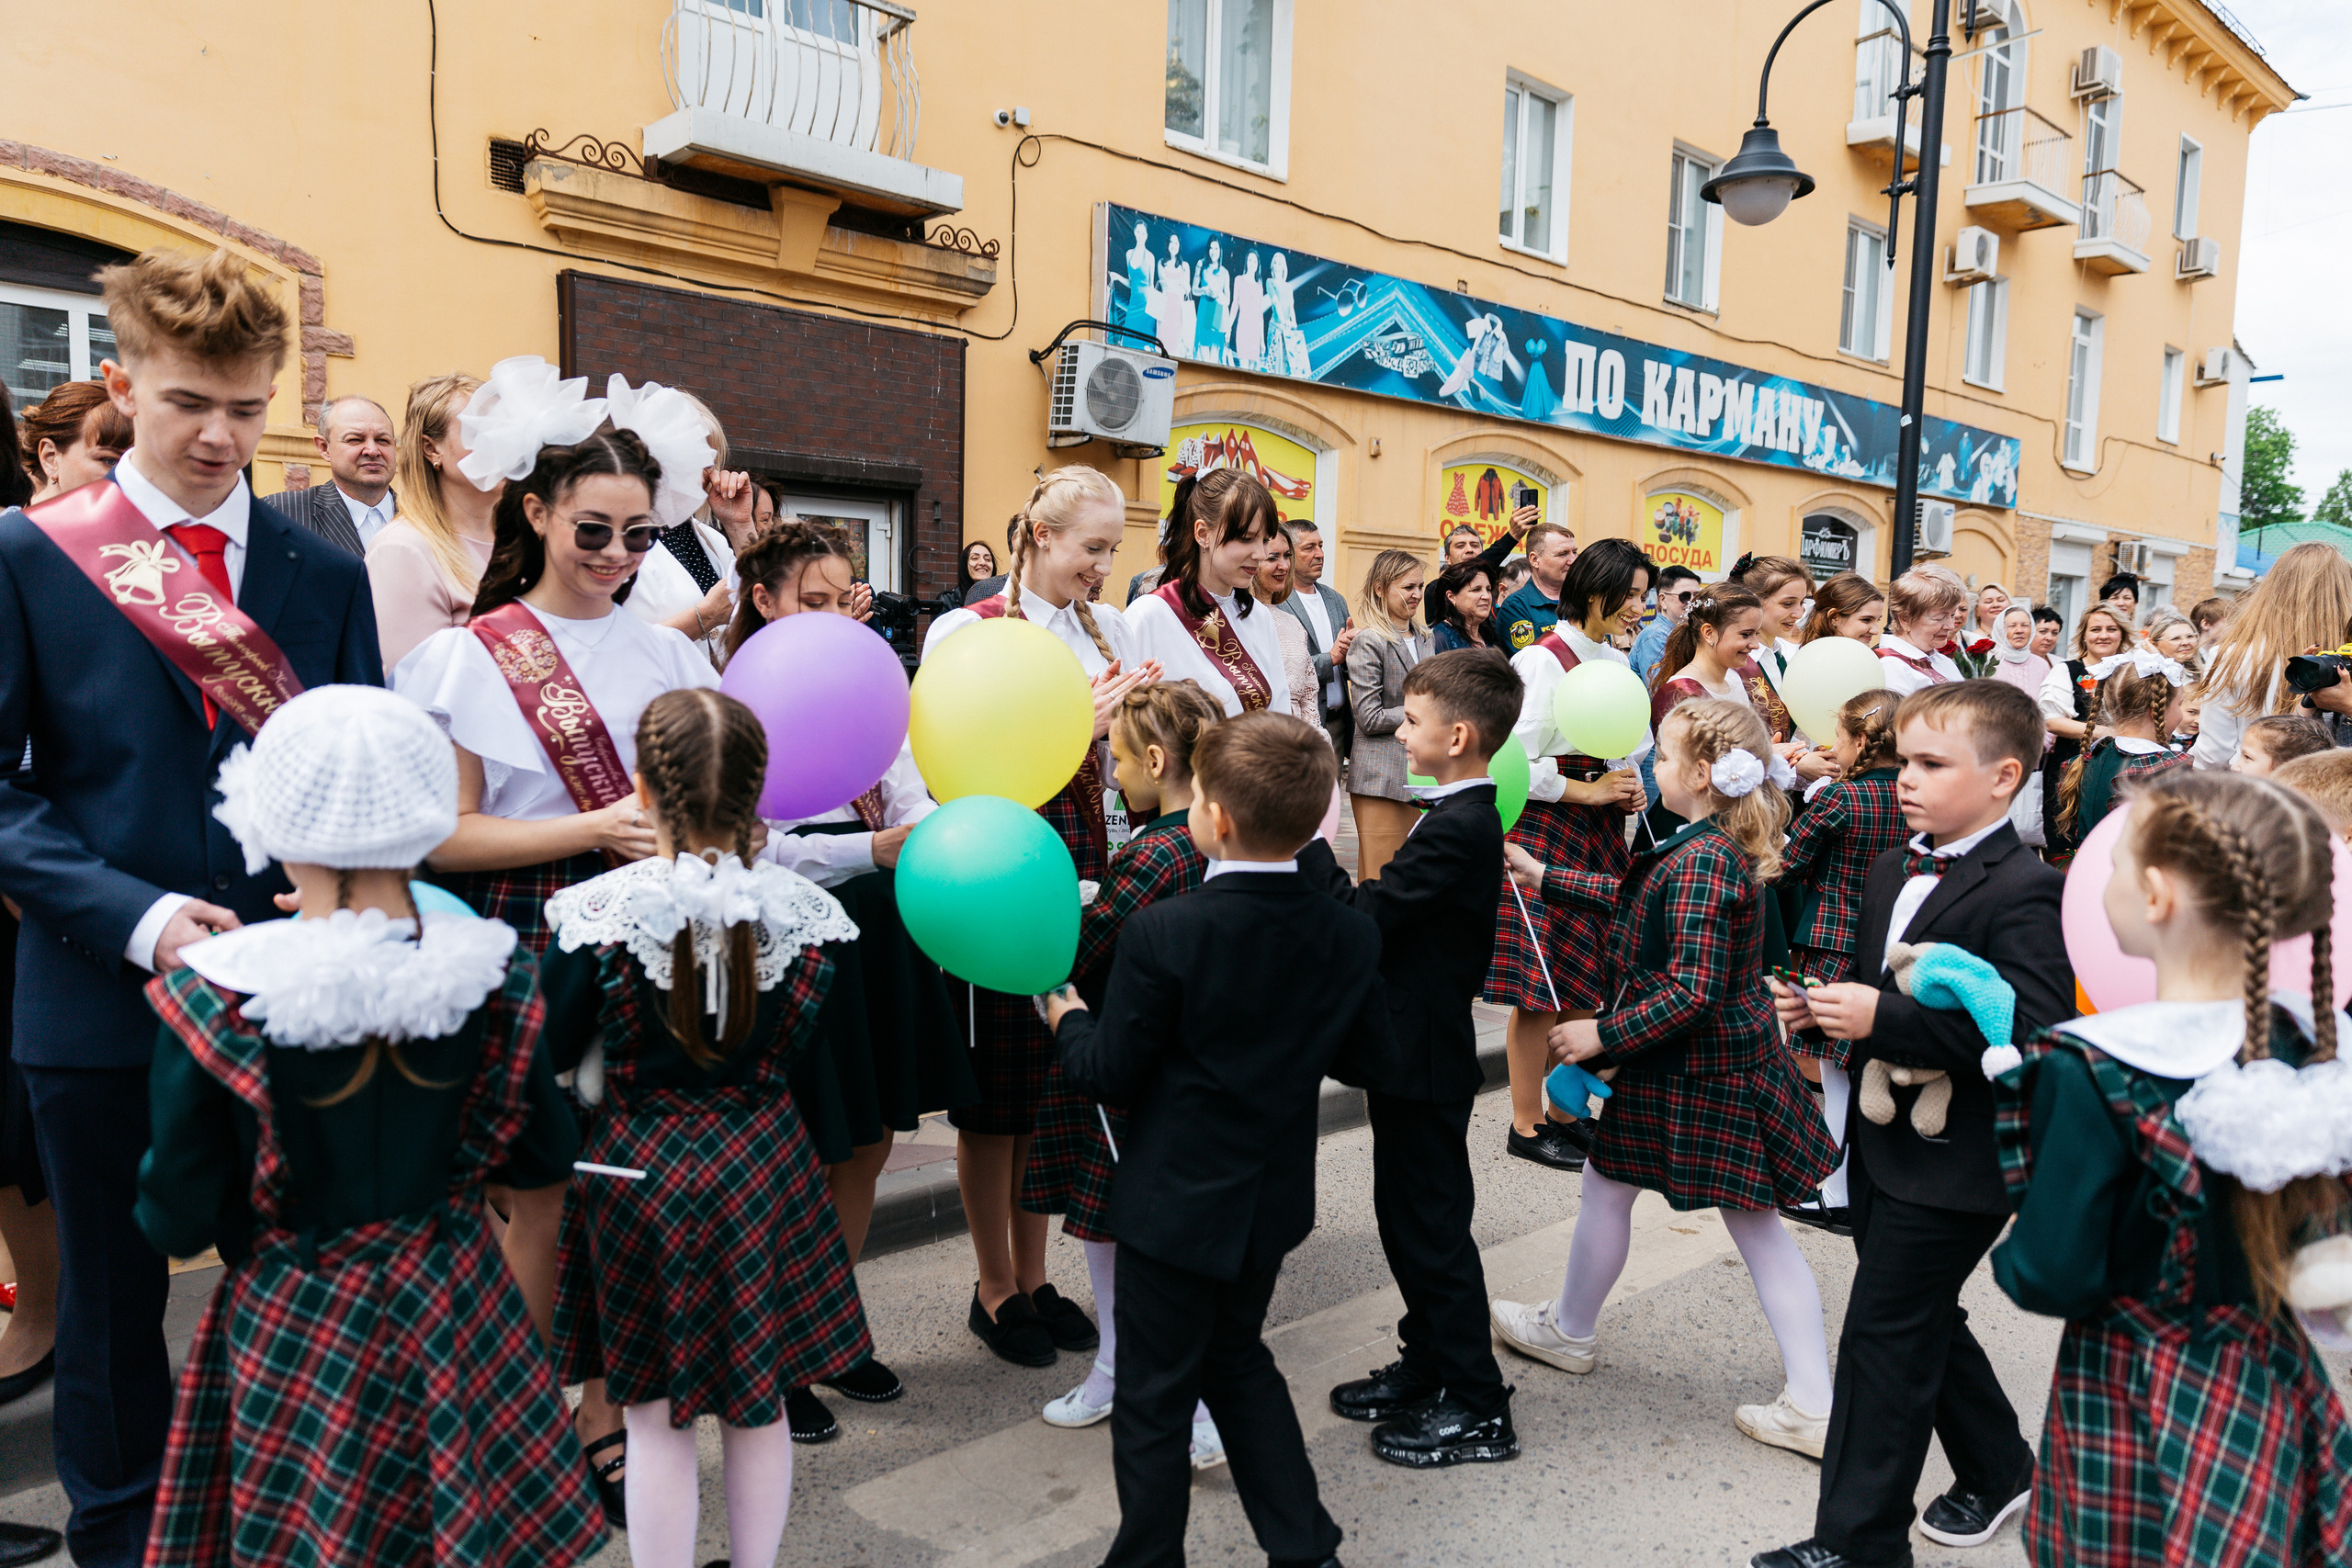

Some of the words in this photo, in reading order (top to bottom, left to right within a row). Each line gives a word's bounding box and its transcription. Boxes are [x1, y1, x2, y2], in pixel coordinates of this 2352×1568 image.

[1146, 367, 1171, 378] SAMSUNG
[1562, 339, 1626, 420] ПО
[1641, 358, 1826, 457] КАРМАНУ
[1440, 519, 1527, 552] ОЕЖ
[1644, 543, 1713, 570] ПОСУДА
[158, 592, 281, 714] Выпускн
[1105, 814, 1130, 826] ZEN
